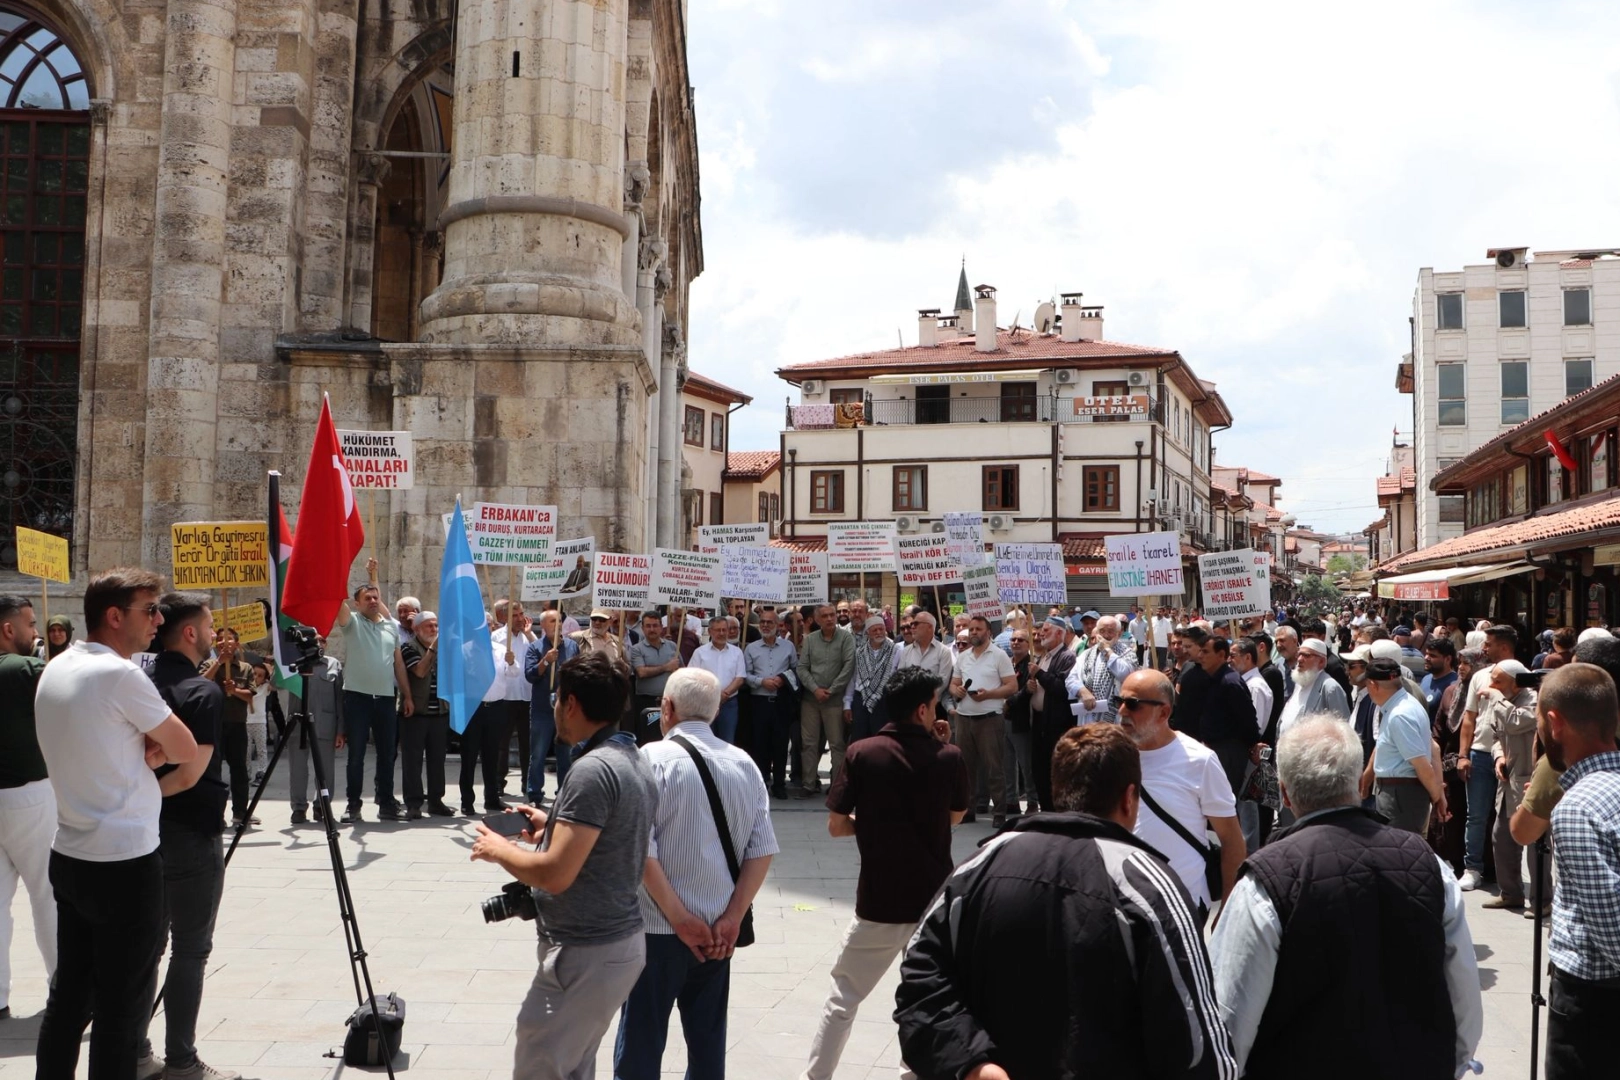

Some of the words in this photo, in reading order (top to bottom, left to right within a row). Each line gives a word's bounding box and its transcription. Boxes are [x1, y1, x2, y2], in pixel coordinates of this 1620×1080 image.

[937, 375, 966, 383] PALAS
[1084, 395, 1137, 406] OTEL
[1078, 407, 1106, 415] ESER
[1110, 406, 1144, 414] PALAS
[343, 433, 395, 446] HÜKÜMET
[341, 446, 401, 458] KANDIRMA,
[345, 459, 408, 473] ANALARI
[348, 474, 397, 488] KAPAT!
[481, 506, 550, 522] ERBAKAN'ca
[514, 524, 554, 535] KURTARACAK
[712, 527, 733, 535] HAMAS
[734, 526, 765, 534] Karşısında
[516, 535, 549, 549] ÜMMETİ
[713, 536, 725, 544] NAL
[725, 535, 755, 543] TOPLAYAN
[931, 537, 946, 545] KAP
[174, 545, 203, 563] Terör
[473, 552, 483, 561] ve
[485, 549, 503, 562] TÜM
[702, 546, 718, 554] Siyon
[924, 547, 941, 558] KÖR
[600, 554, 631, 568] ZULME
[789, 555, 810, 566] ÇİNİZ
[217, 564, 237, 584] ÇOK
[239, 564, 267, 582] YAKIN
[927, 571, 942, 580] DEF
[1079, 566, 1107, 574] GAYRİ
[596, 569, 650, 587] ZULÜMDÜR!
[600, 598, 622, 608] SESSİZ
